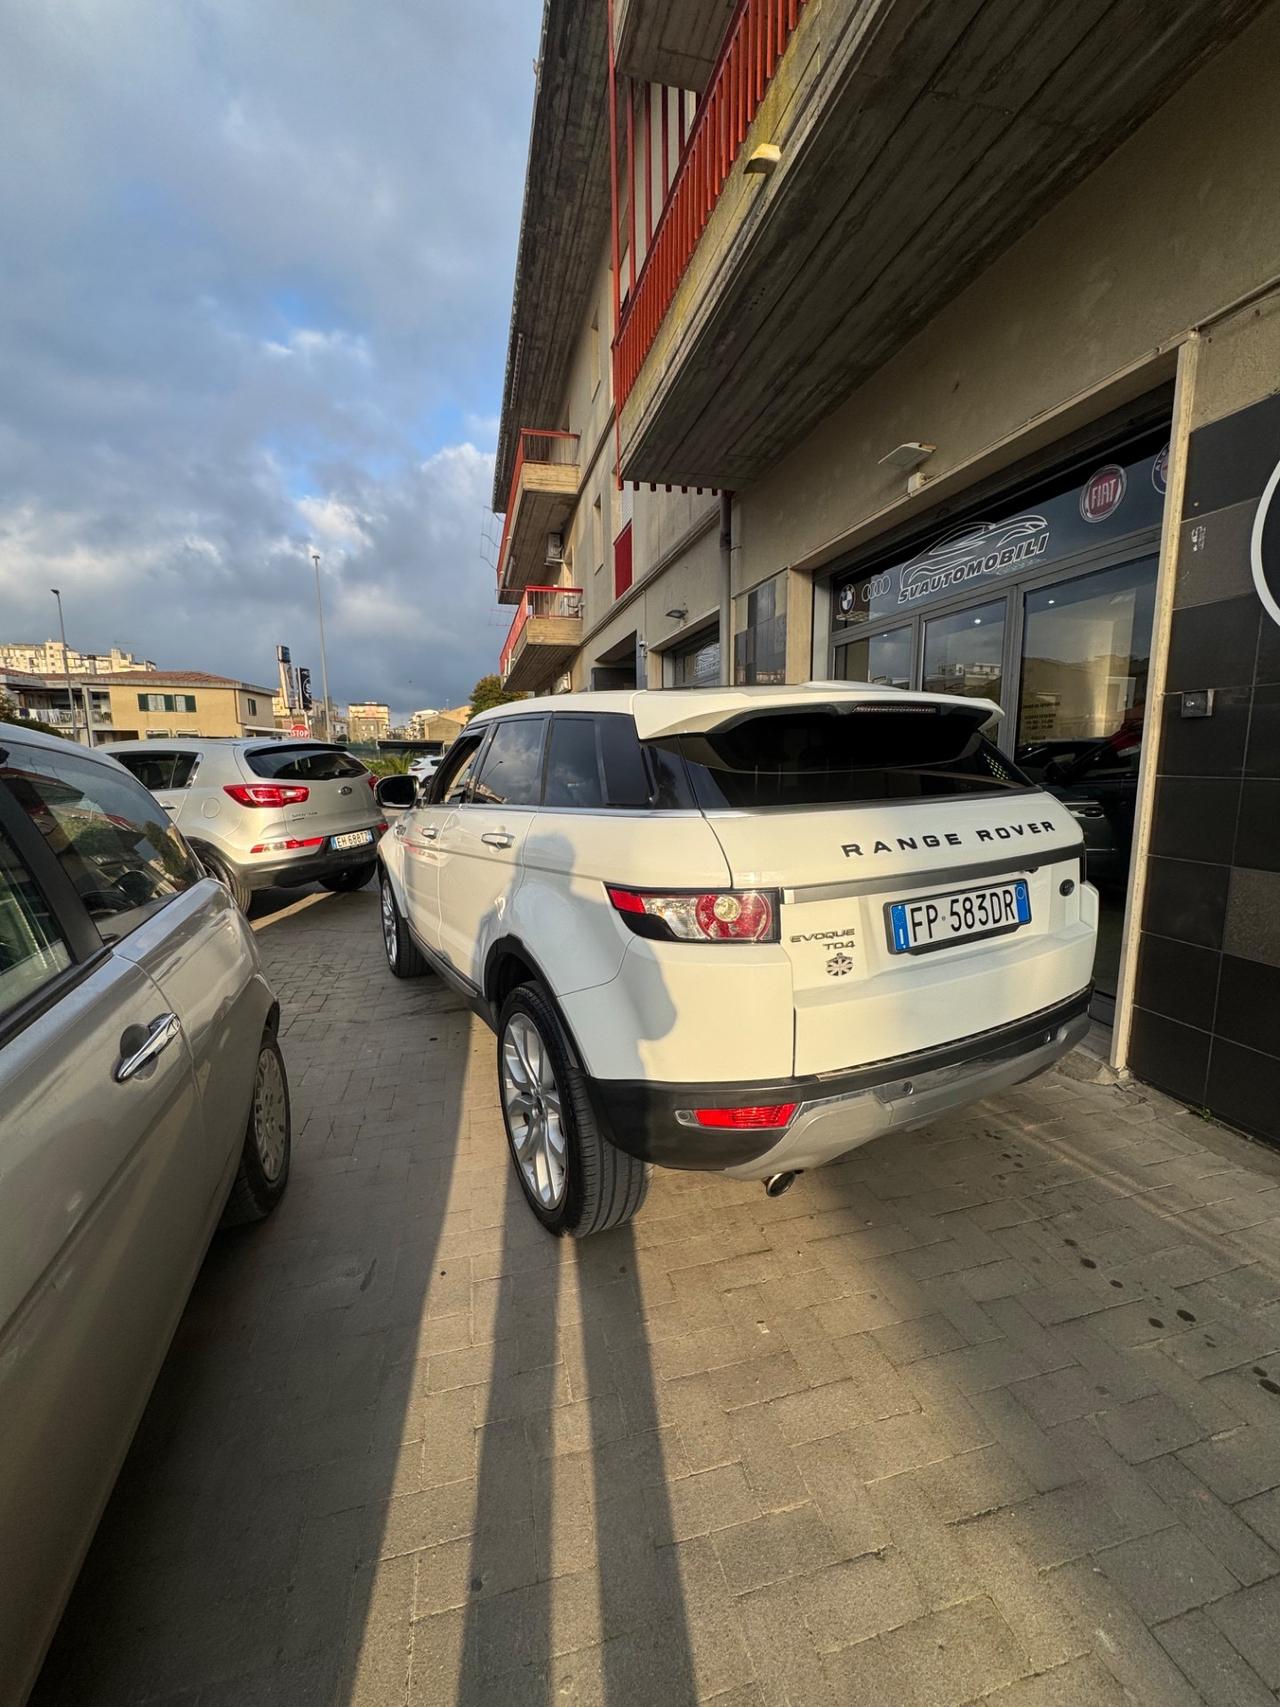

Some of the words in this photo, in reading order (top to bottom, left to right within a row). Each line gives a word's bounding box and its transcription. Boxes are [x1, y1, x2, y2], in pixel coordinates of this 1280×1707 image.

[1091, 478, 1117, 510] FIAT
[898, 532, 1049, 604] SVAUTOMOBILI
[291, 729, 310, 738] STOP
[841, 833, 962, 857] RANGE
[976, 821, 1056, 842] ROVER
[910, 904, 938, 942] FP
[949, 889, 1016, 932] 583DR
[790, 928, 856, 943] EVOQUE
[823, 940, 856, 950] TD4
